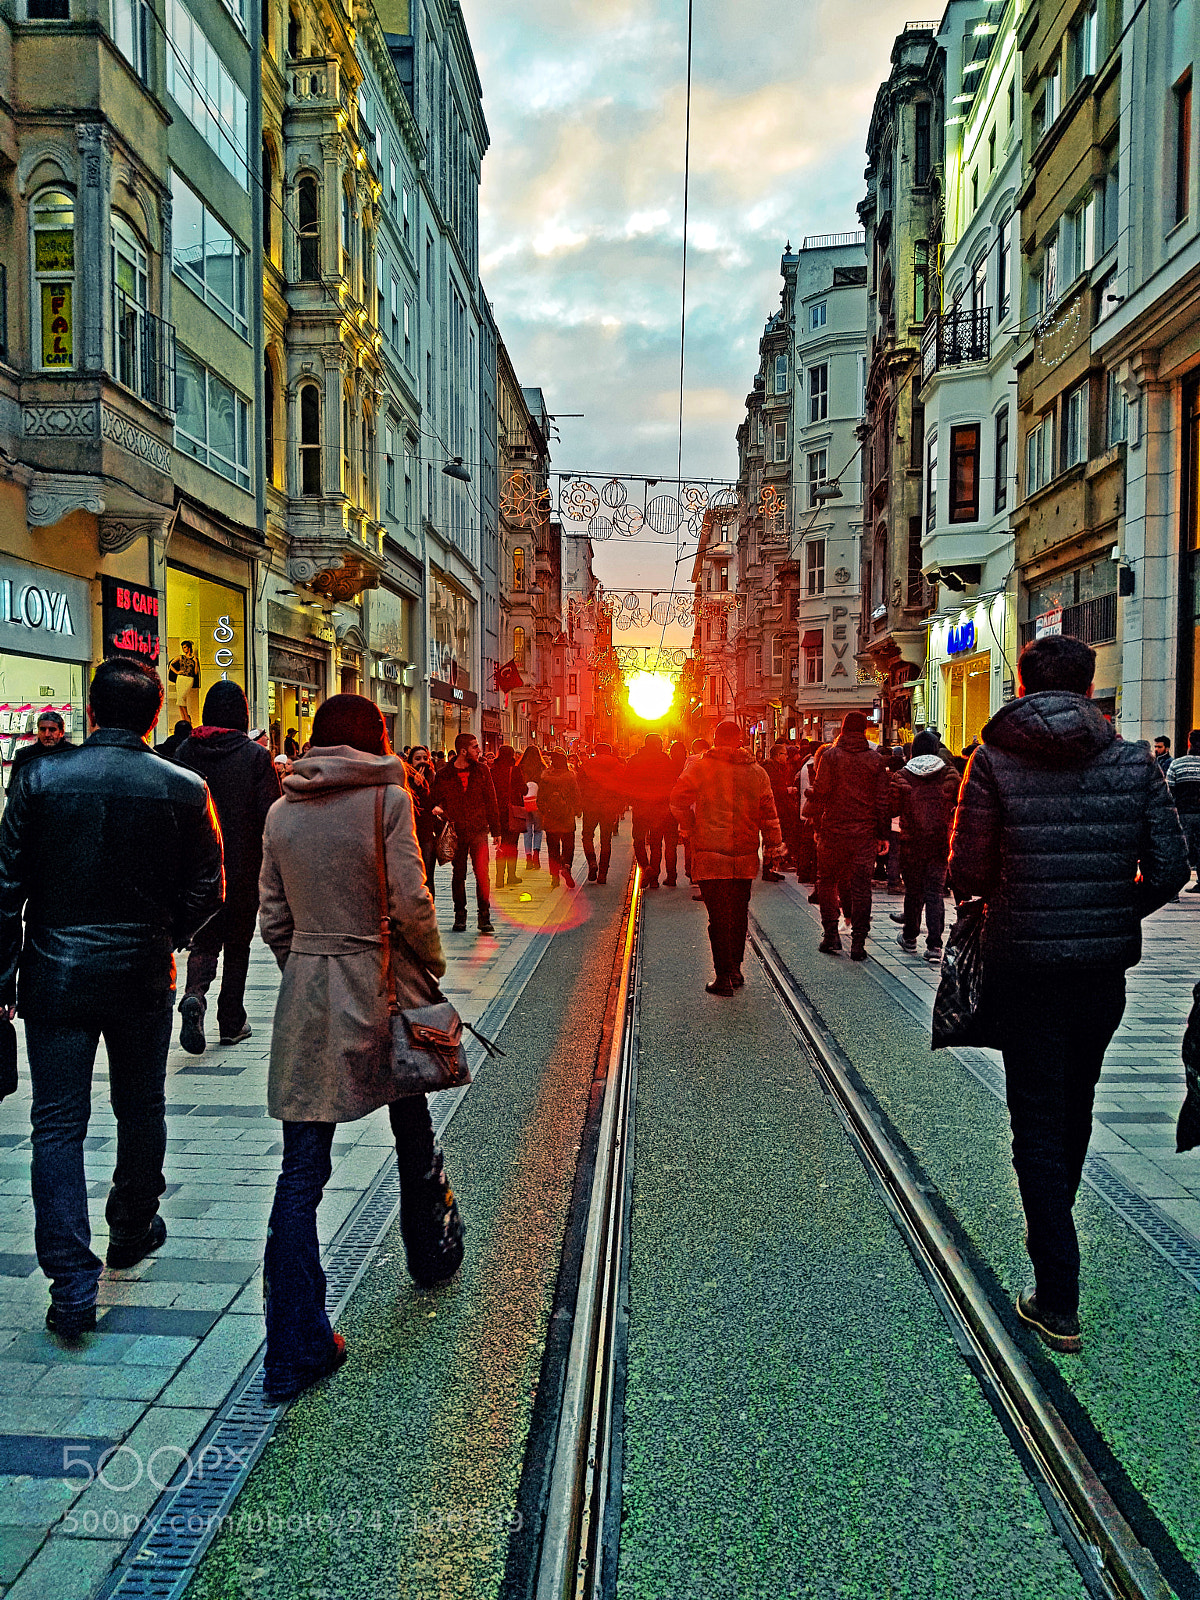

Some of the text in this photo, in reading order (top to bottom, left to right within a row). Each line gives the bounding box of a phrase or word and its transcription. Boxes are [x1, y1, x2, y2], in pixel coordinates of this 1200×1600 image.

[53, 297, 69, 354] FAL
[3, 579, 75, 636] LOYA
[116, 587, 159, 617] ES CAFE
[831, 606, 849, 677] PEVA
